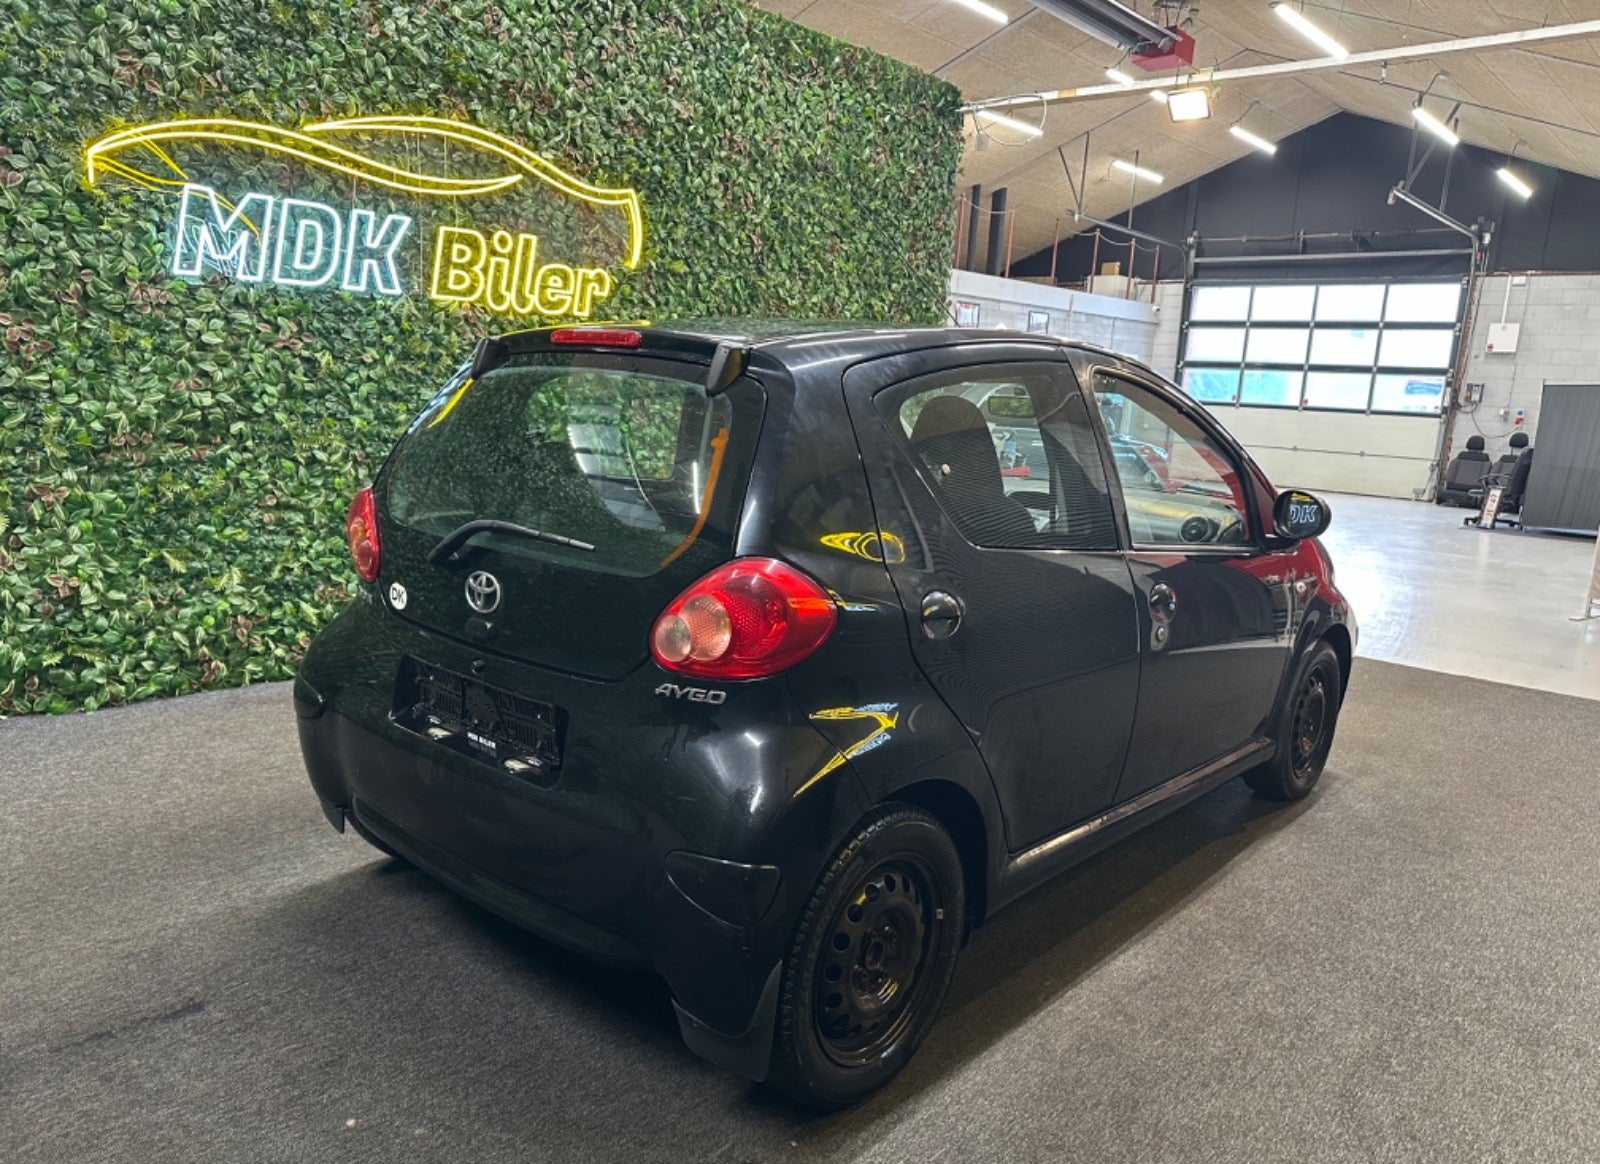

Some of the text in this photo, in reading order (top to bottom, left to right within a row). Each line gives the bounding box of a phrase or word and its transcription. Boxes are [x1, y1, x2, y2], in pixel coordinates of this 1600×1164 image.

[172, 183, 610, 318] MDK Biler
[391, 586, 405, 604] DK
[655, 683, 727, 705] AYGO
